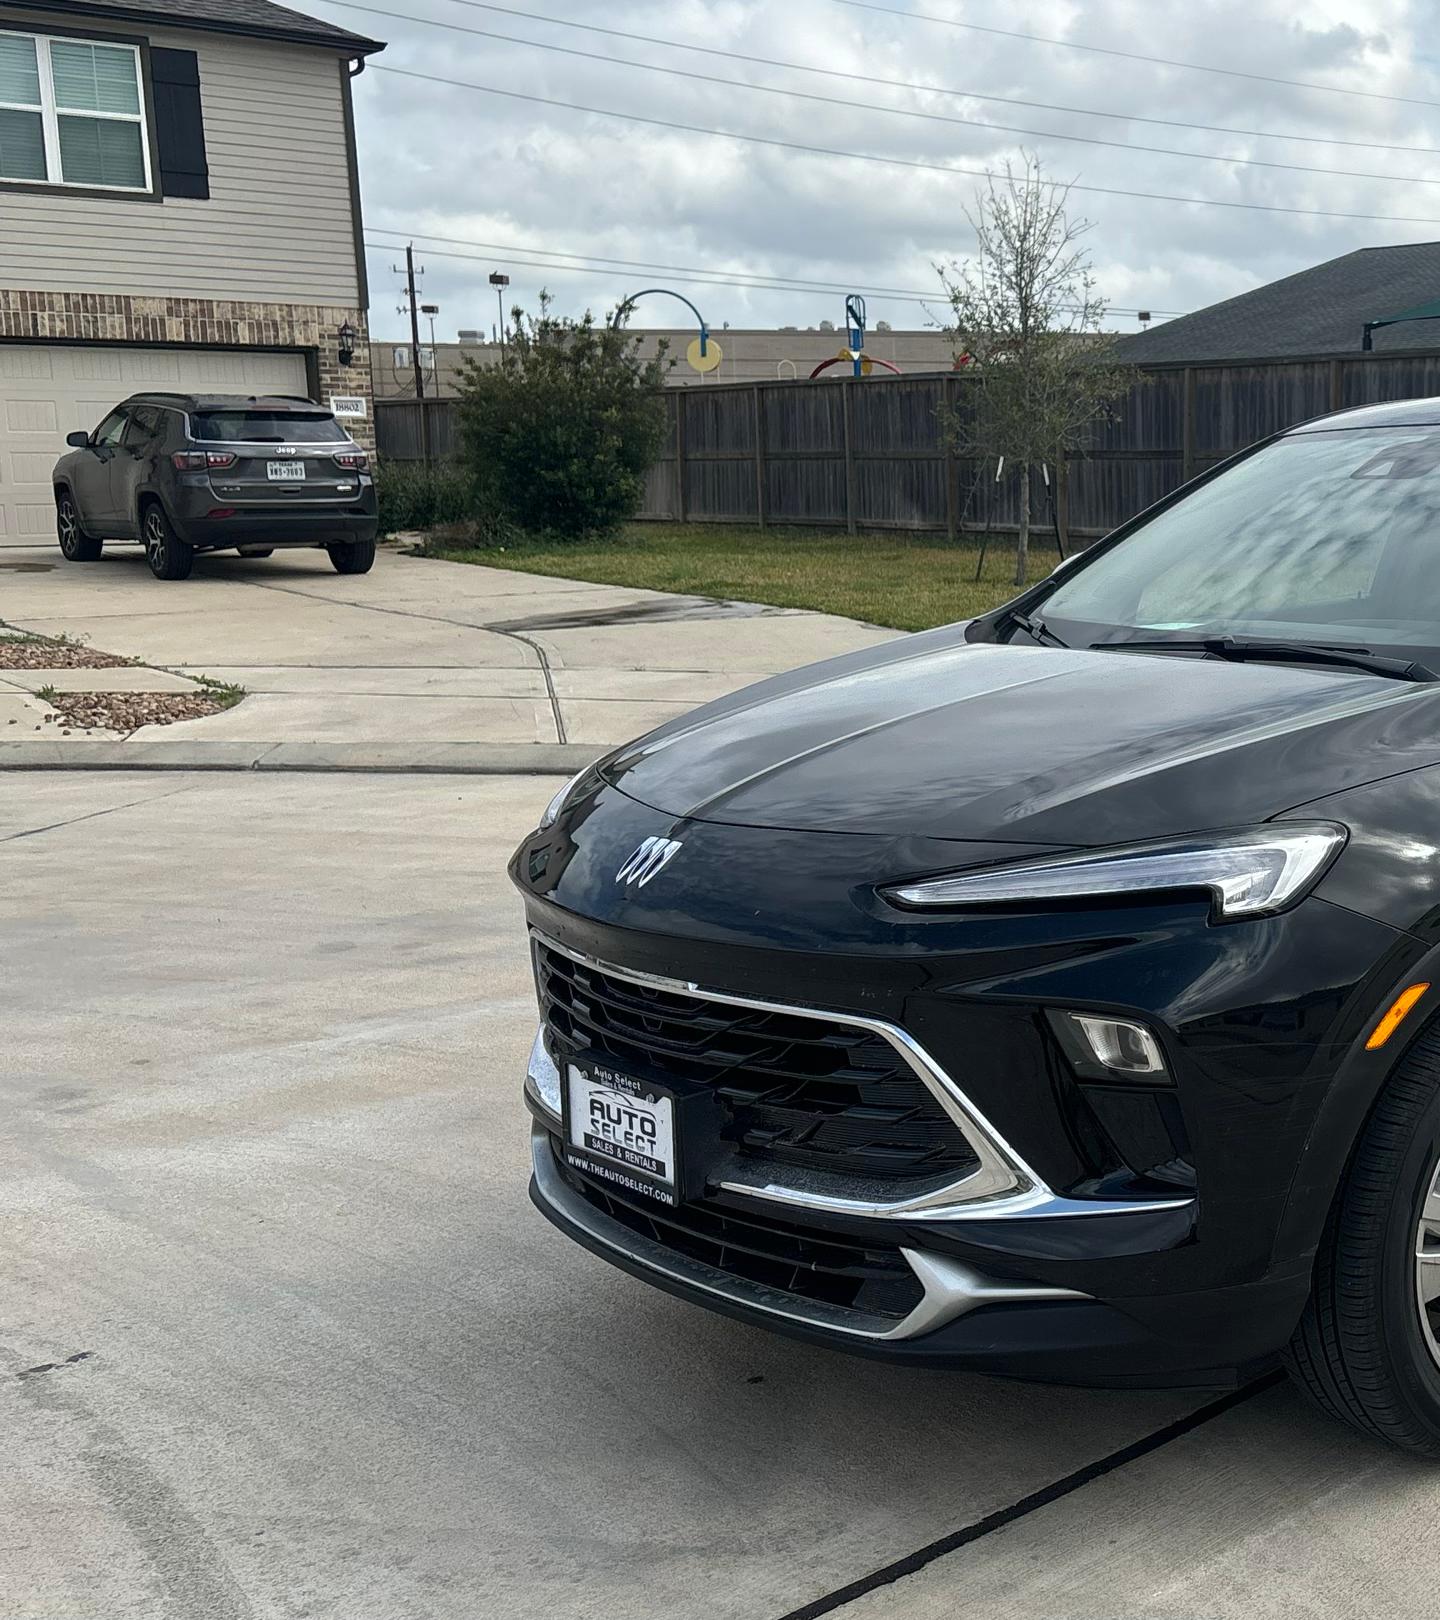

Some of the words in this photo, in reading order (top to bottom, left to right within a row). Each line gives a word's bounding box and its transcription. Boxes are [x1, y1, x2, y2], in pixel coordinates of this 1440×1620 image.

[275, 446, 297, 455] Jeep
[593, 1065, 612, 1081] Auto
[614, 1073, 641, 1091] Select
[589, 1098, 657, 1138] AUTO
[590, 1118, 657, 1157] SELECT
[592, 1138, 614, 1155] SALES
[616, 1147, 622, 1158] &
[625, 1150, 657, 1172] RENTALS
[567, 1153, 673, 1206] WWW.THEAUTOSELECT.COM
